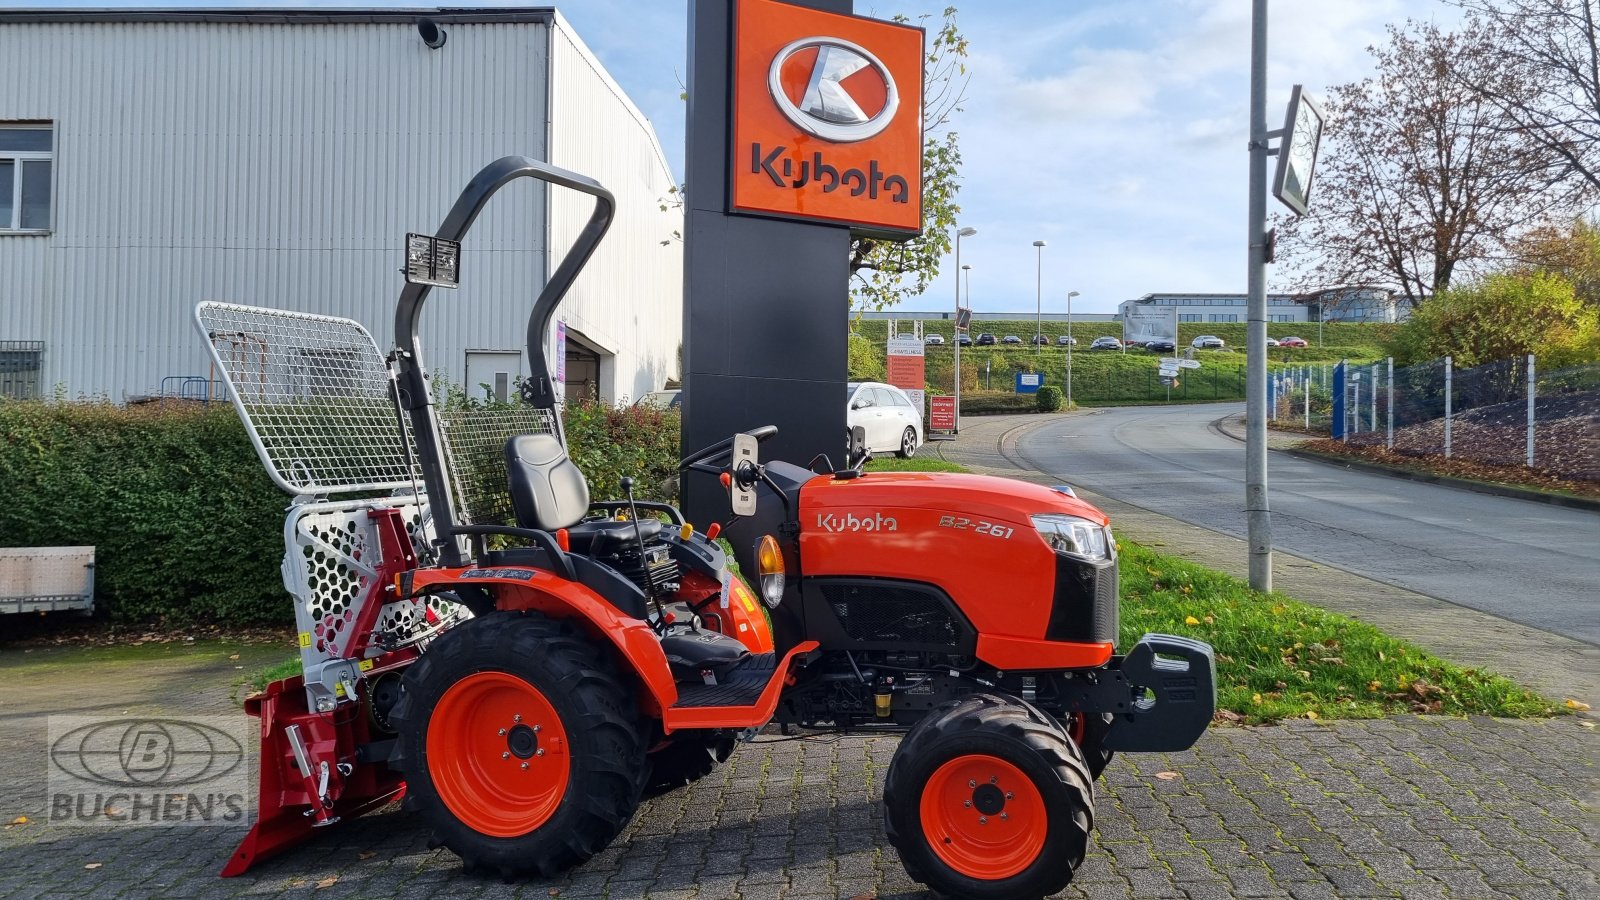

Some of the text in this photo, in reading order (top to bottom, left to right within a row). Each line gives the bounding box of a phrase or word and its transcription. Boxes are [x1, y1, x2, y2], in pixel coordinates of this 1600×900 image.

[752, 142, 908, 203] Kubota
[817, 512, 897, 532] Kubota
[939, 515, 1014, 539] B2-261
